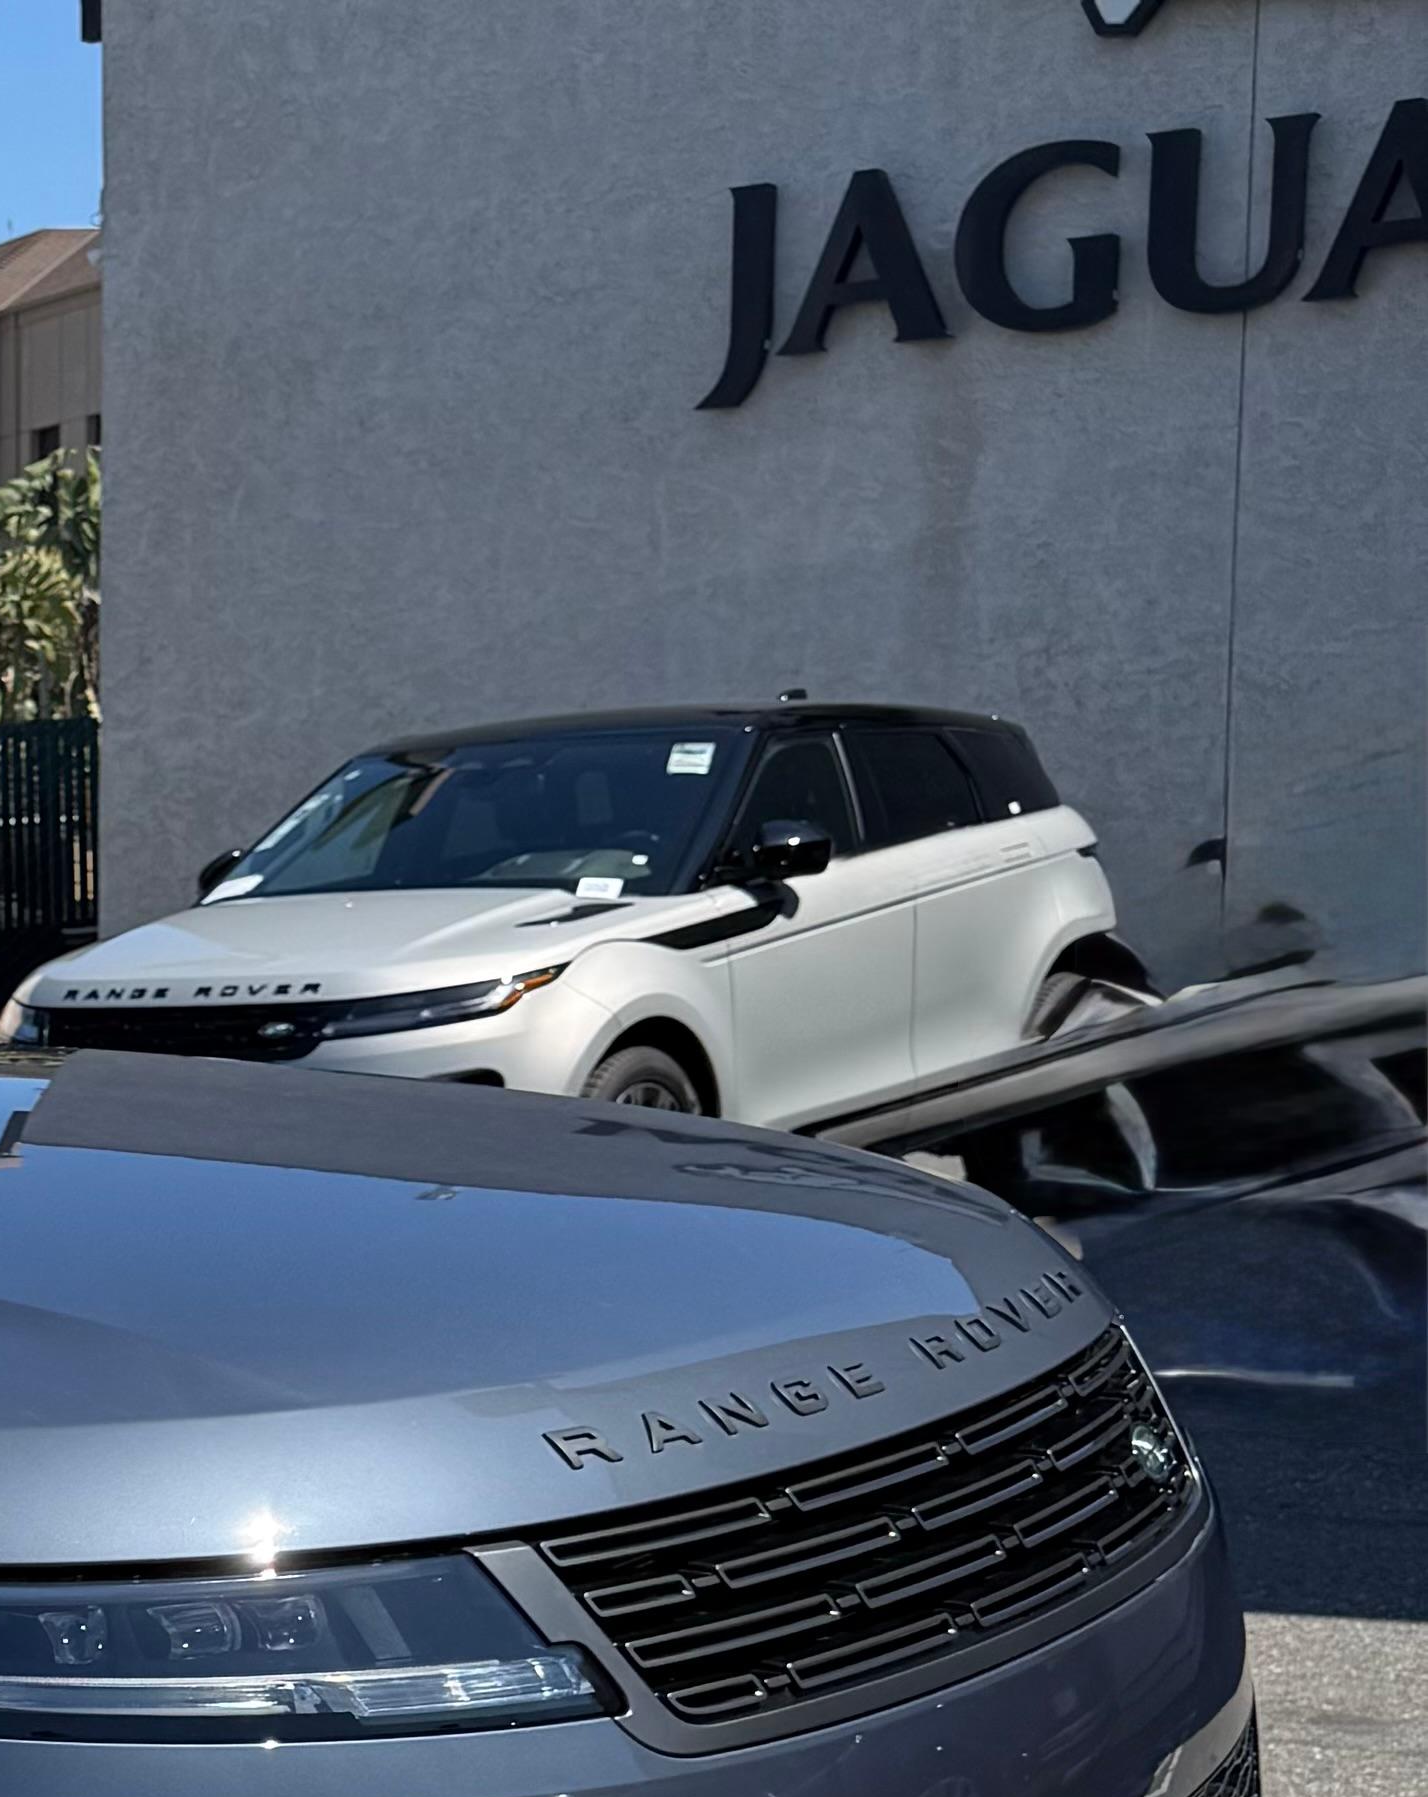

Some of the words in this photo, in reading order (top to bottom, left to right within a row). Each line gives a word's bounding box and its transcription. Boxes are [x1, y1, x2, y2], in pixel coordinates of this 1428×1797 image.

[63, 987, 170, 1000] RANGE
[193, 983, 321, 998] ROVER
[541, 1362, 886, 1471] RANGE
[907, 1271, 1084, 1370] ROVER
